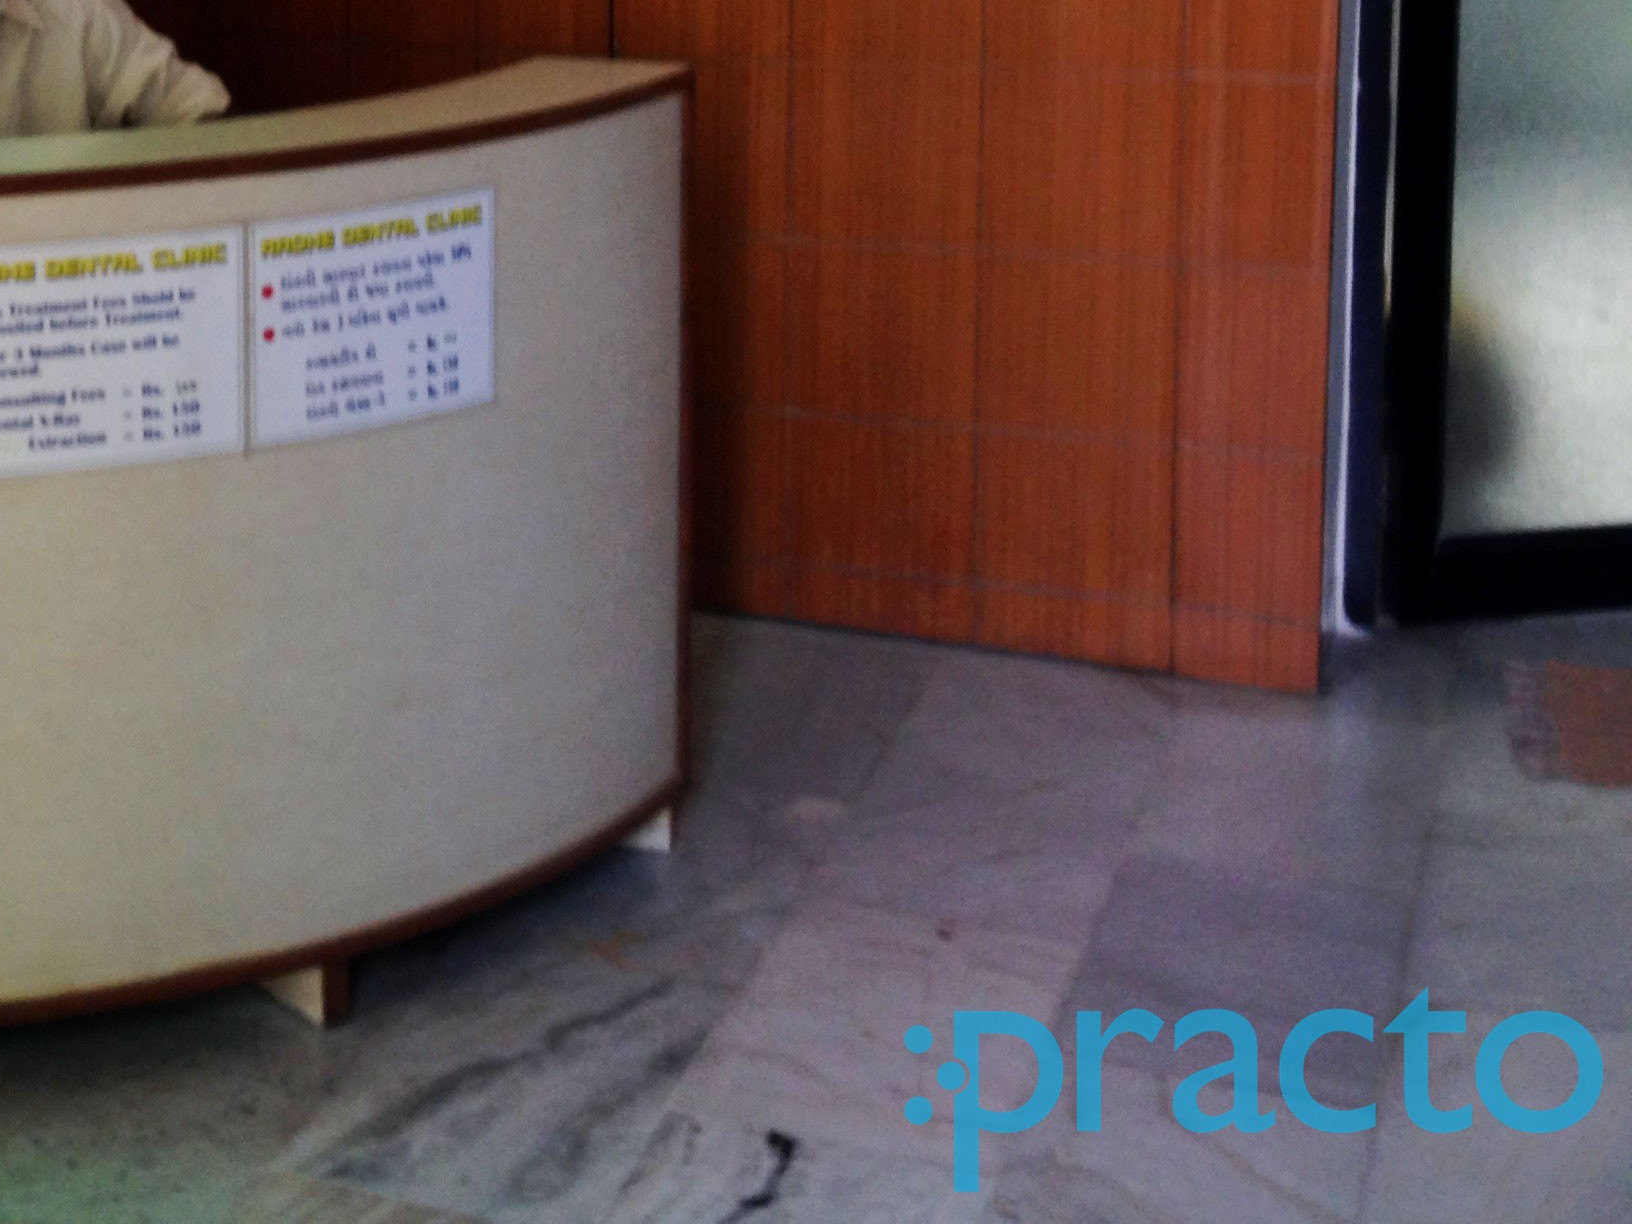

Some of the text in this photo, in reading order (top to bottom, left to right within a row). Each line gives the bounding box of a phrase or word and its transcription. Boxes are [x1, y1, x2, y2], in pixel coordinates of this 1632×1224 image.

[341, 217, 420, 248] DENTAL
[425, 204, 483, 234] CLINIC
[44, 251, 144, 279] DENTAL
[152, 243, 227, 269] CLINIC
